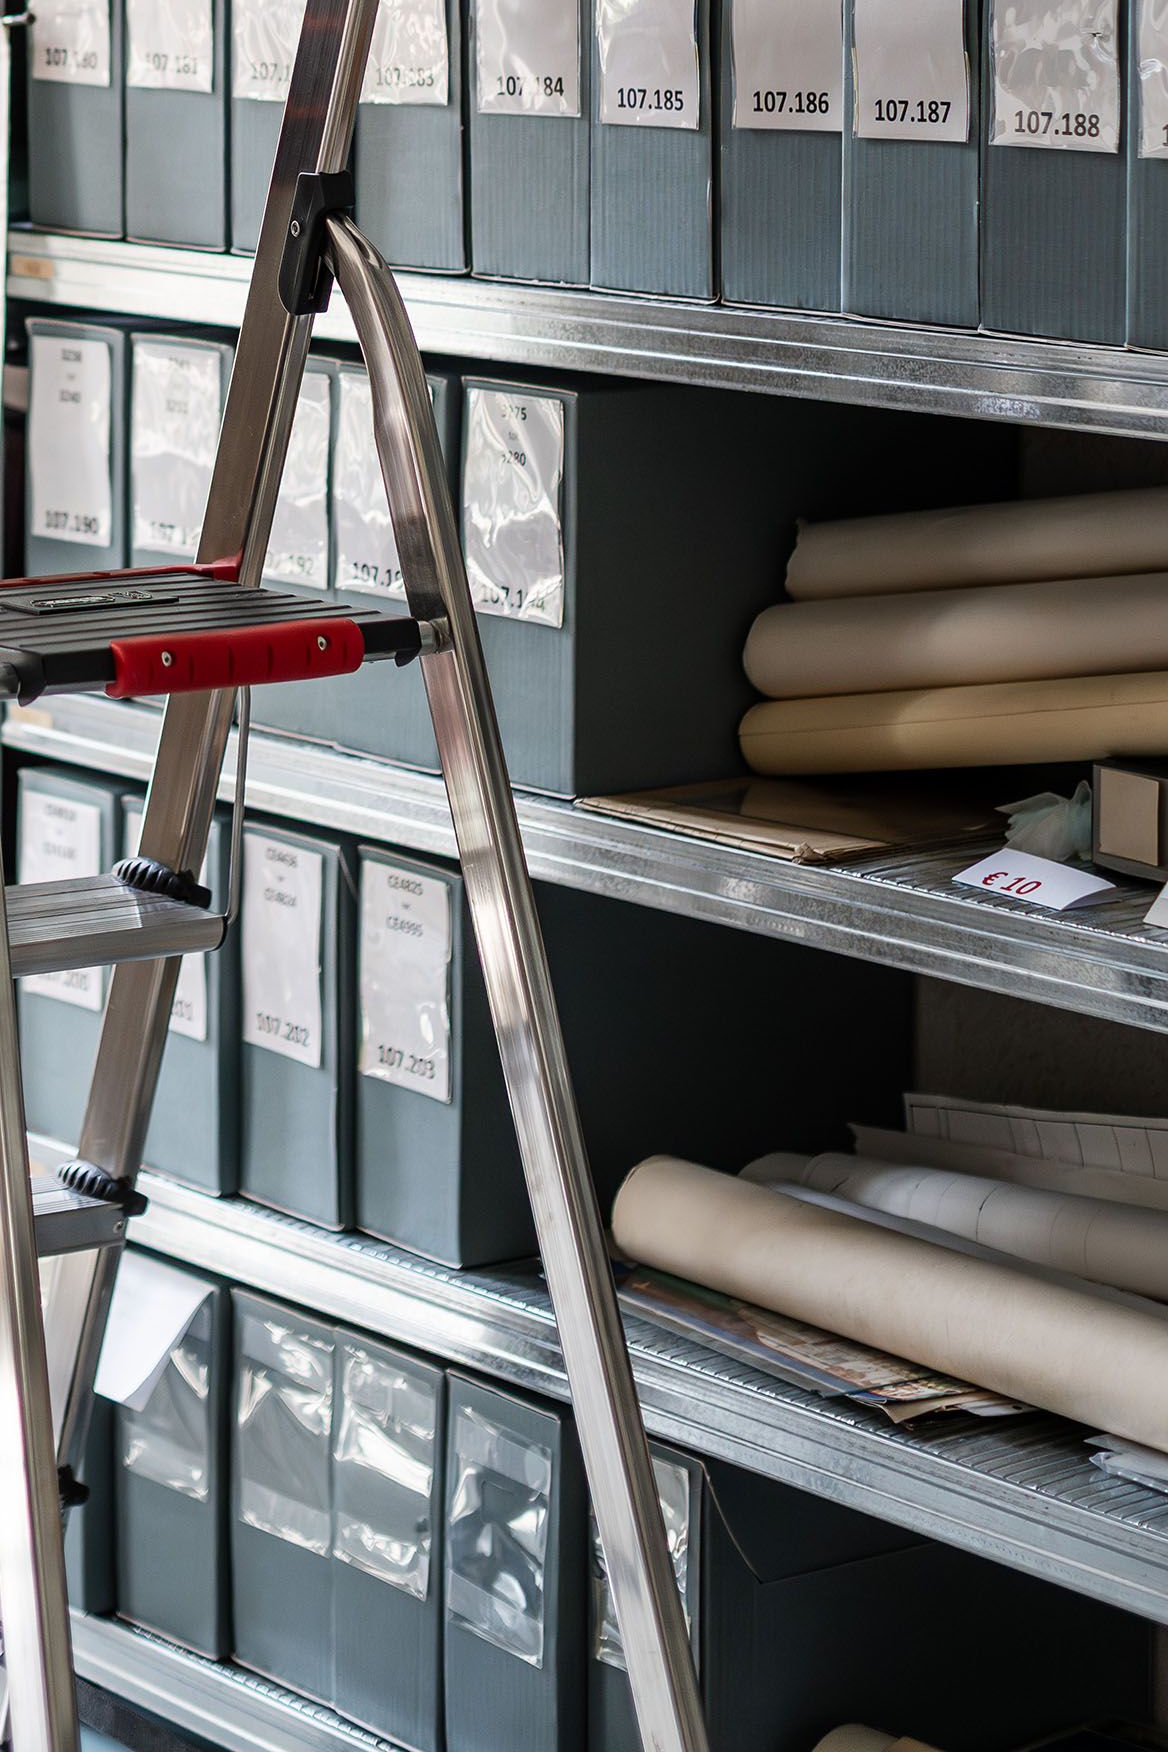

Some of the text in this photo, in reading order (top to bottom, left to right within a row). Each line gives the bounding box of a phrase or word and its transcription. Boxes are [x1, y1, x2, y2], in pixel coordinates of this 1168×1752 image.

[45, 47, 98, 70] 107180
[145, 52, 198, 75] 107181
[251, 63, 292, 83] 107.1
[496, 76, 565, 97] 107184
[617, 88, 684, 111] 107.185
[753, 91, 830, 114] 107.186
[874, 99, 952, 124] 107.187
[1014, 110, 1101, 137] 107.188
[982, 871, 1042, 895] € 10
